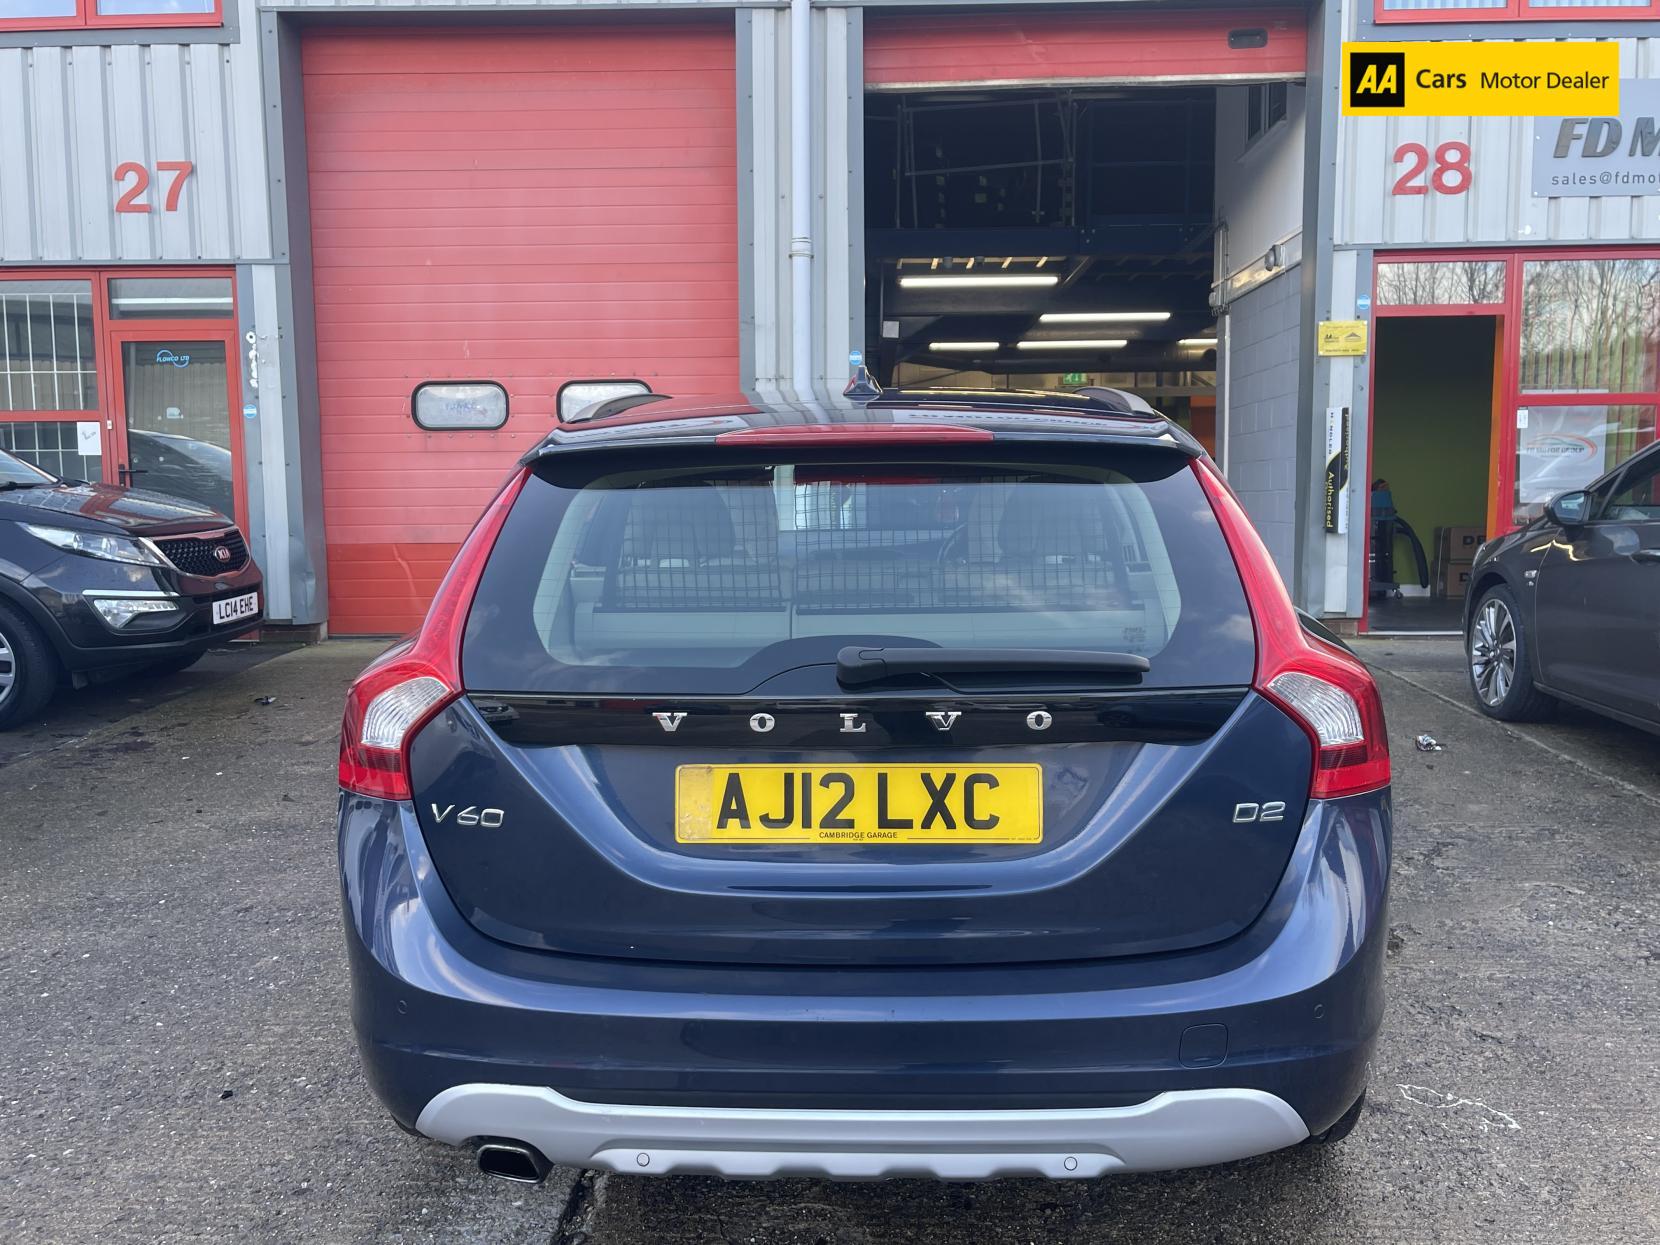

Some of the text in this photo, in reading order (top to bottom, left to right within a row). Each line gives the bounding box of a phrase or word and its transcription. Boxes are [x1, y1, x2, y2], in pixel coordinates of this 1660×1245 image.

[1553, 117, 1623, 159] FD
[1392, 142, 1472, 195] 28
[114, 161, 194, 213] 27
[1326, 471, 1335, 528] Authorised
[218, 596, 254, 620] LC14 EHE
[652, 710, 1053, 733] VOLVO
[431, 803, 505, 828] V60
[716, 772, 1000, 830] AJ12 LXC
[1233, 801, 1286, 823] D2
[819, 831, 898, 839] CAMBRIDGE GARAGE
